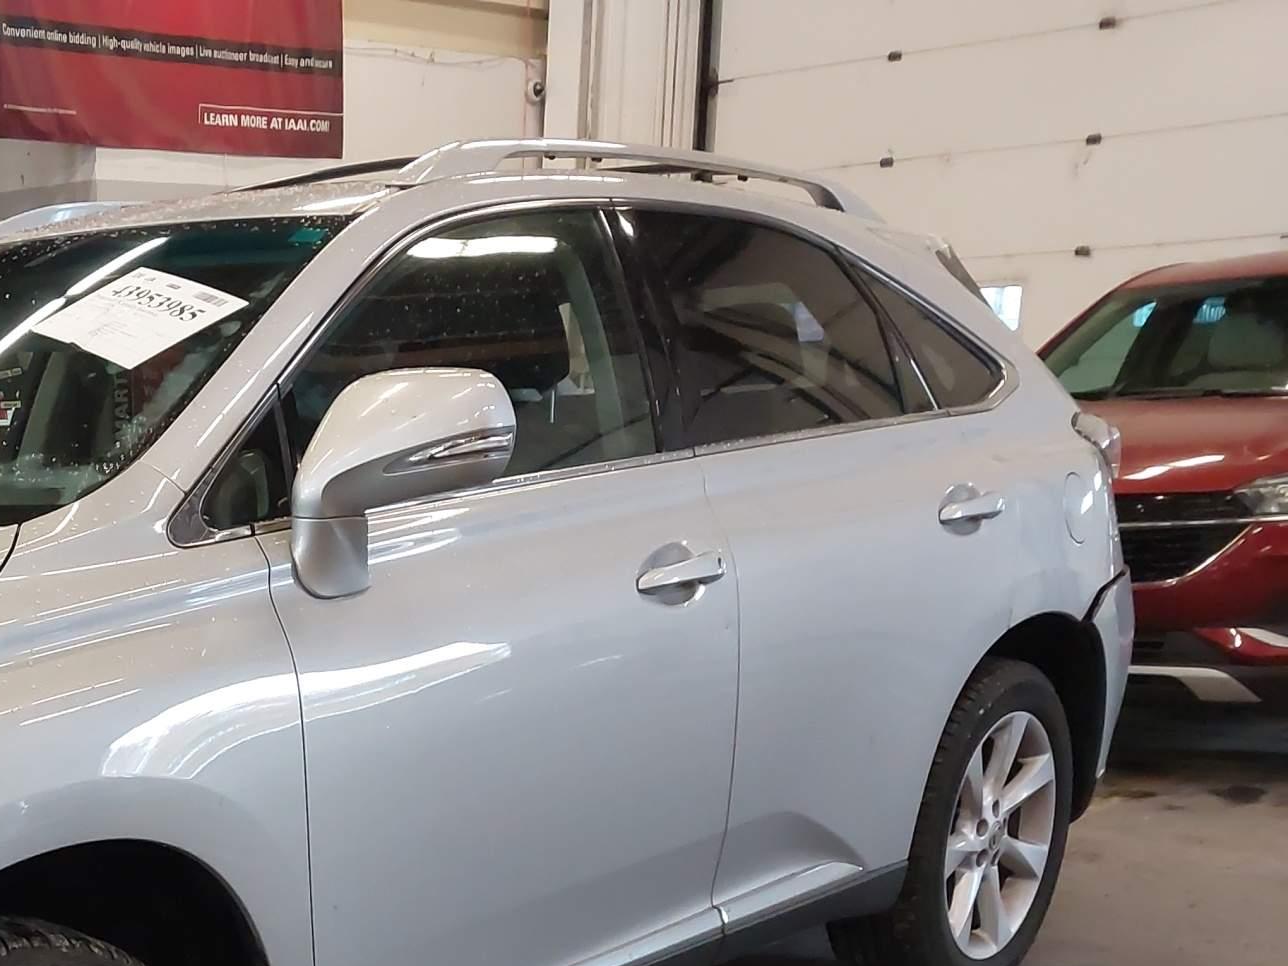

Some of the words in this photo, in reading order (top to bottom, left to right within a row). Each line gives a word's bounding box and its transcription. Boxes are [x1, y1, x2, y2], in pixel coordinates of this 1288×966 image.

[2, 22, 46, 39] Convenient
[46, 29, 67, 43] online
[69, 31, 96, 48] bidding
[102, 34, 142, 52] High-quality
[143, 40, 166, 54] vehicle
[168, 42, 194, 57] images
[199, 45, 212, 58] Live
[204, 112, 238, 127] LEARN
[240, 114, 268, 129] MORE
[270, 117, 283, 130] AT
[284, 118, 330, 132] IAAI.COM
[112, 285, 206, 321] 43953985
